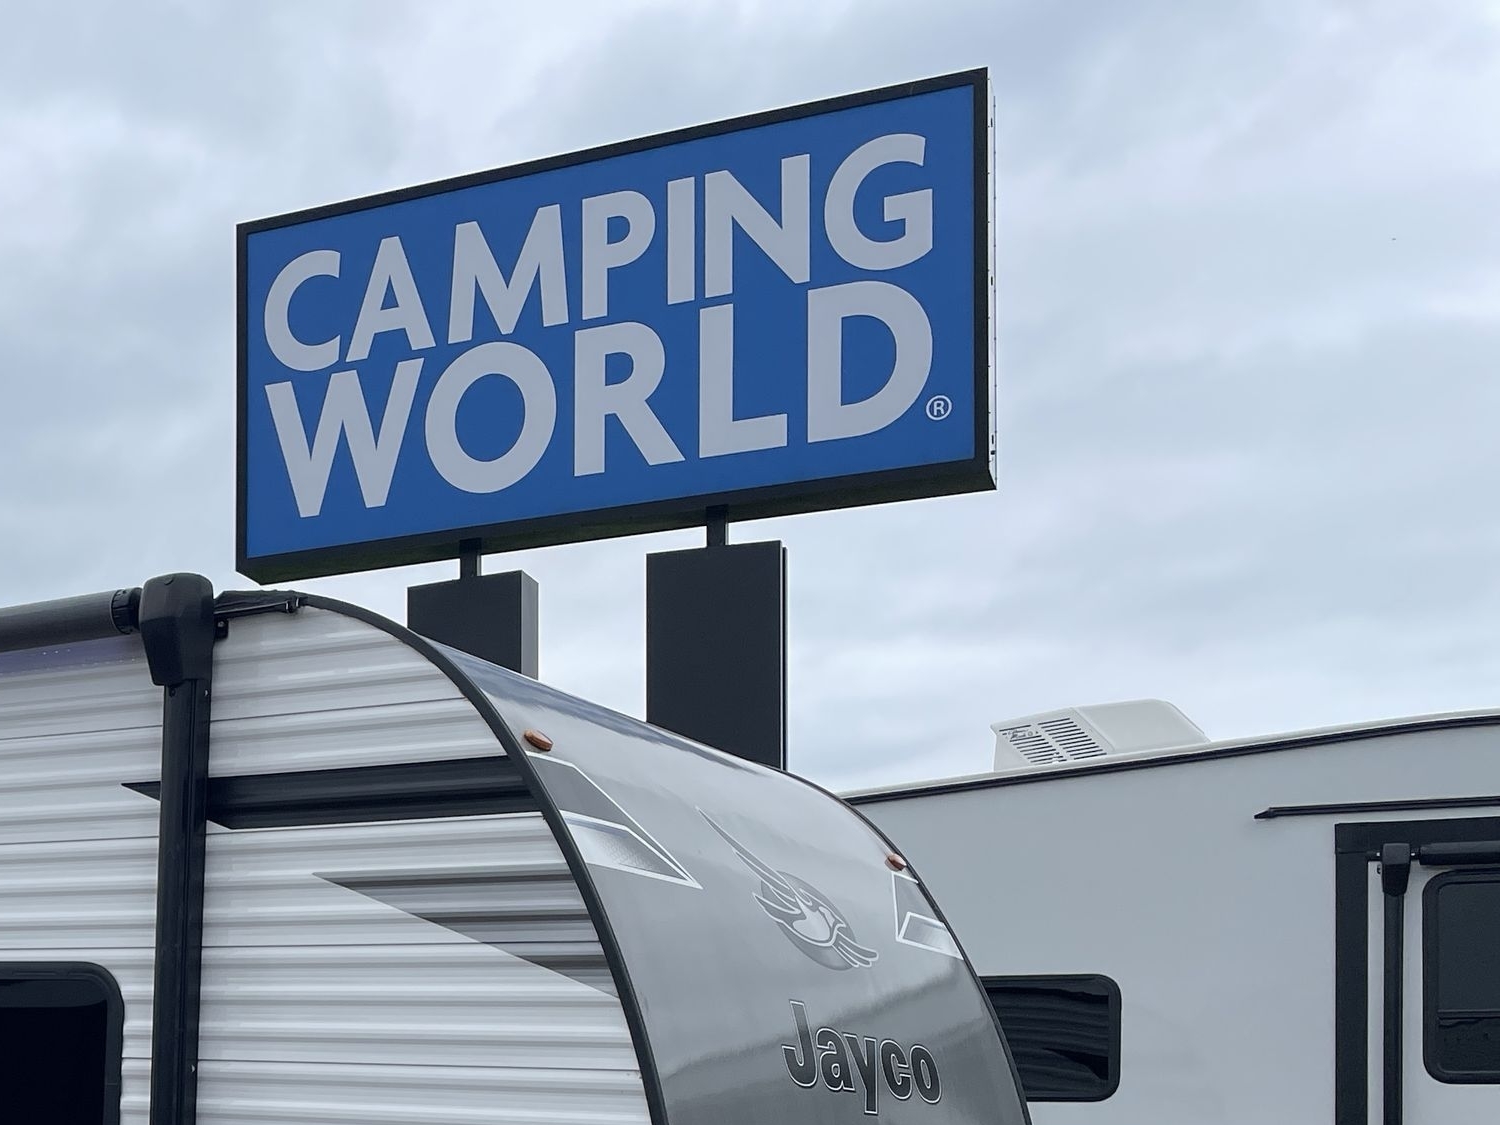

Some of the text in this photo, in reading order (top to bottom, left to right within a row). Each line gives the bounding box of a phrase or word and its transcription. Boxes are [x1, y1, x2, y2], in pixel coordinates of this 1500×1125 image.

[264, 133, 933, 372] CAMPING
[264, 281, 933, 519] WORLD
[781, 999, 942, 1115] Jayco
